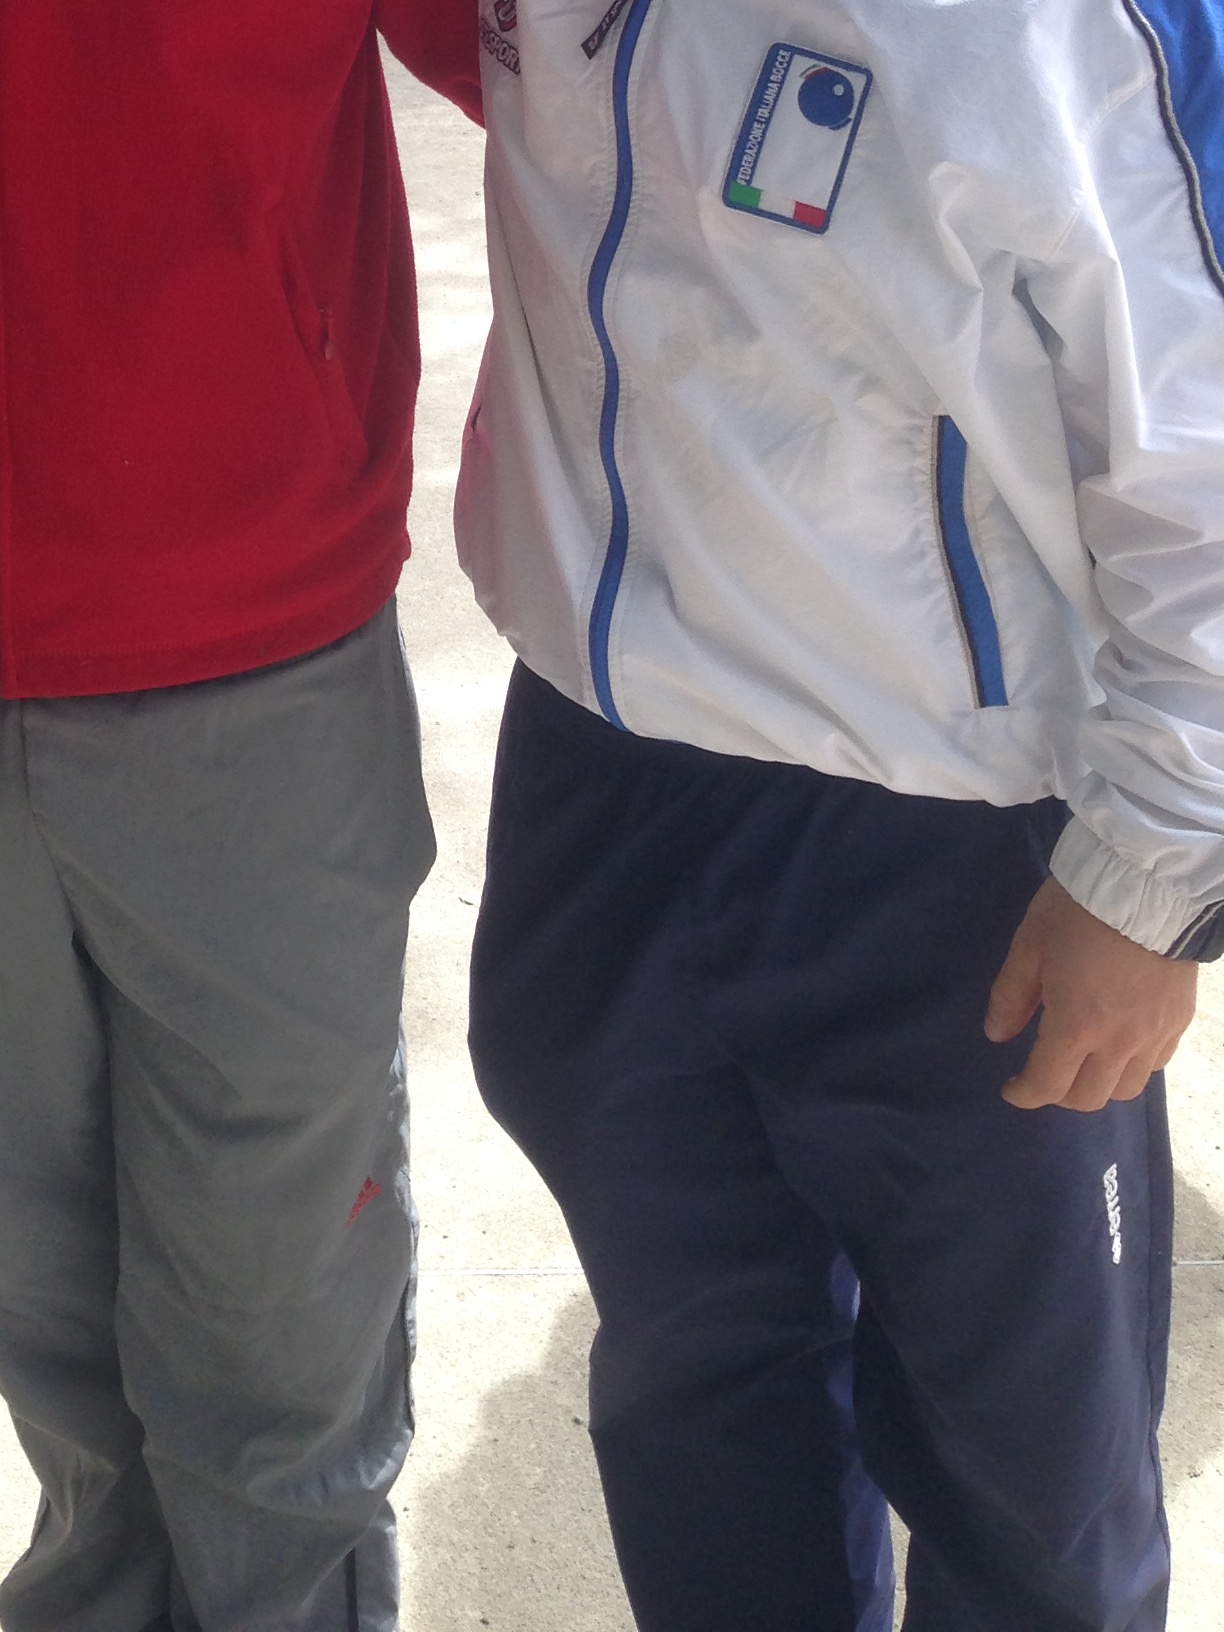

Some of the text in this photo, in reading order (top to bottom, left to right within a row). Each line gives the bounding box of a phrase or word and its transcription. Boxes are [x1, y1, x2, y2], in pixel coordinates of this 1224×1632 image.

[737, 48, 792, 186] FEDERAZIONE ITALIANA BOCCE
